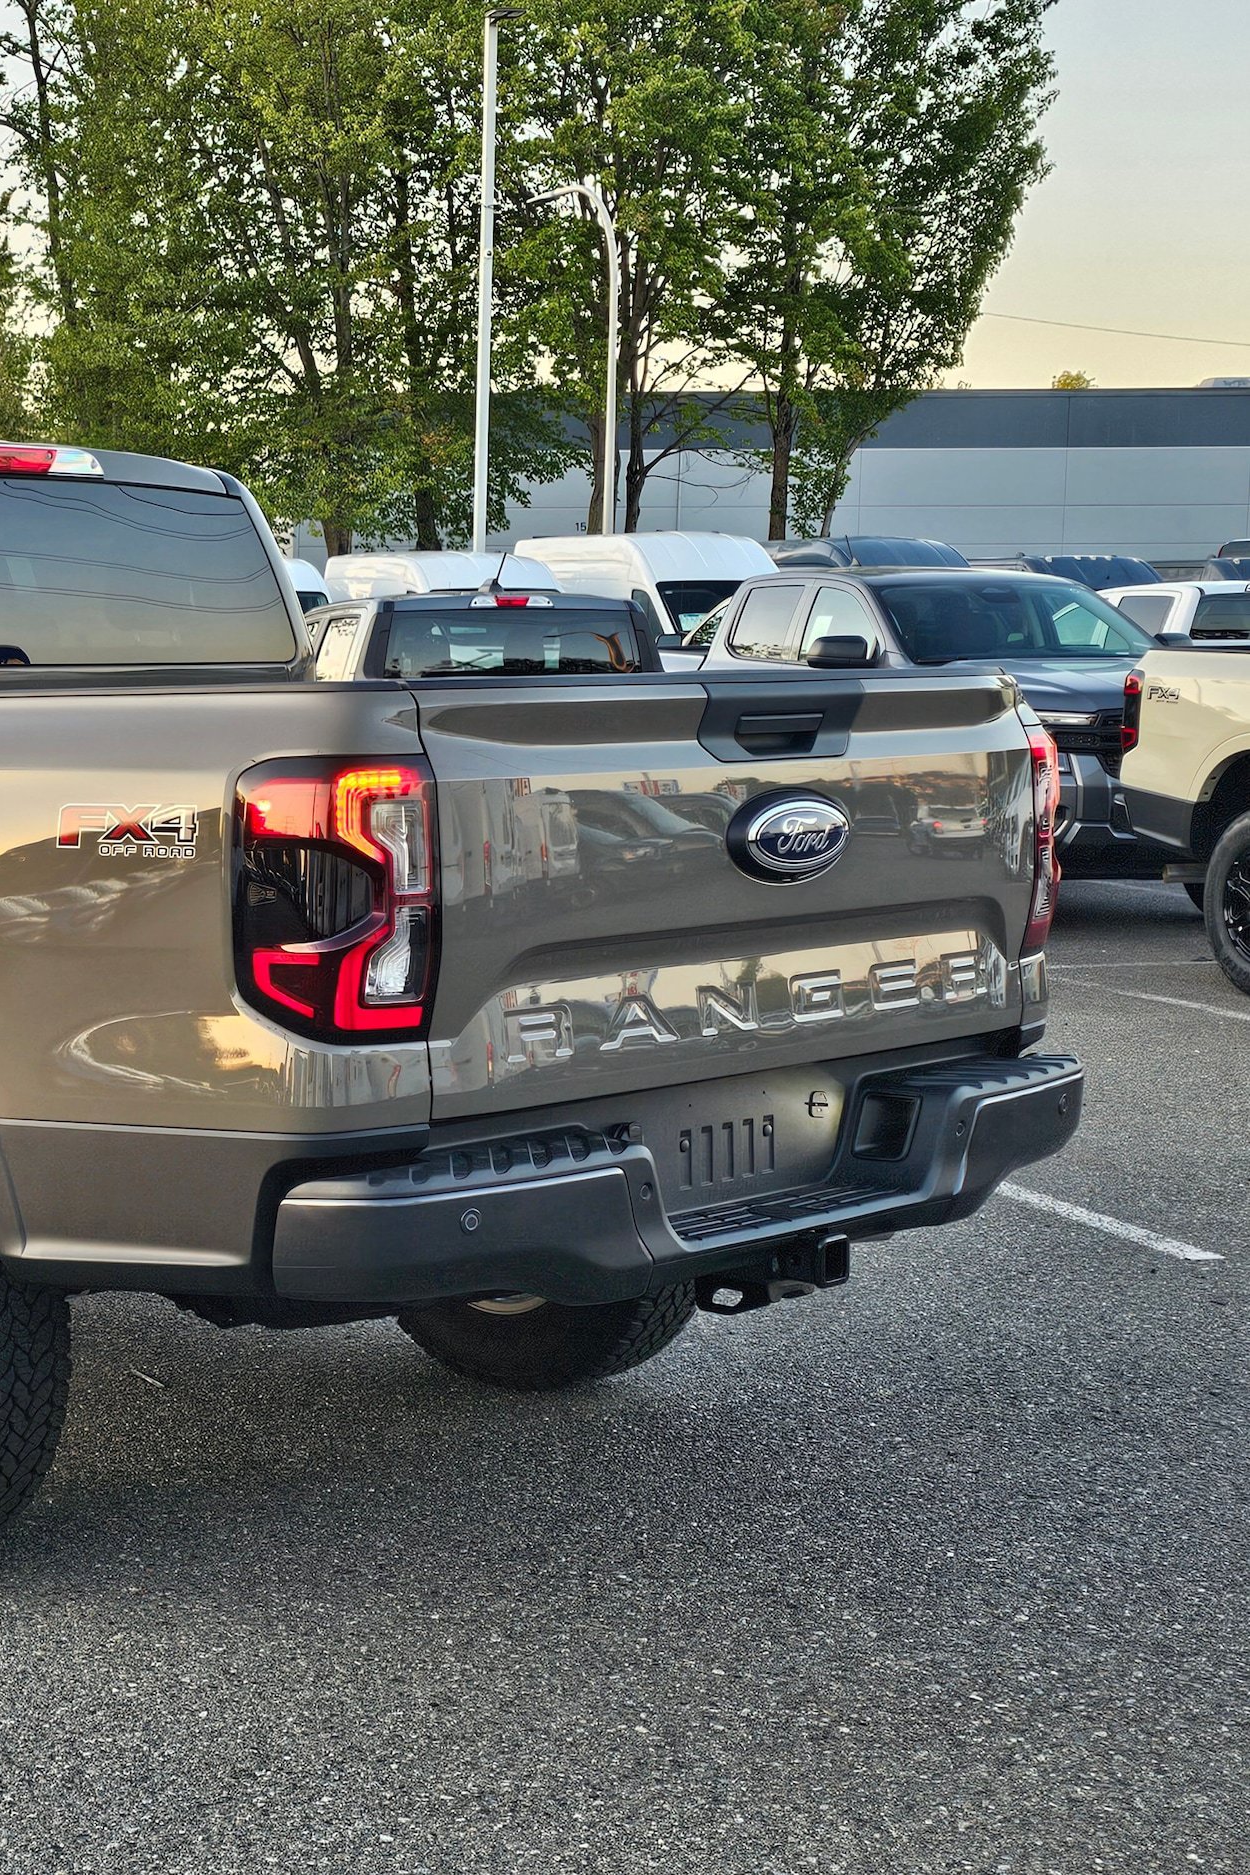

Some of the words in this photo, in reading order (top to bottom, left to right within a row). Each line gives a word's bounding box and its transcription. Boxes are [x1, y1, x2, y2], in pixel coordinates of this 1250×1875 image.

[1147, 686, 1180, 700] FX4
[56, 803, 199, 849] FX4
[776, 816, 831, 855] Ford
[98, 845, 137, 857] OFF
[142, 846, 196, 859] ROAD
[503, 951, 988, 1064] RANGER
